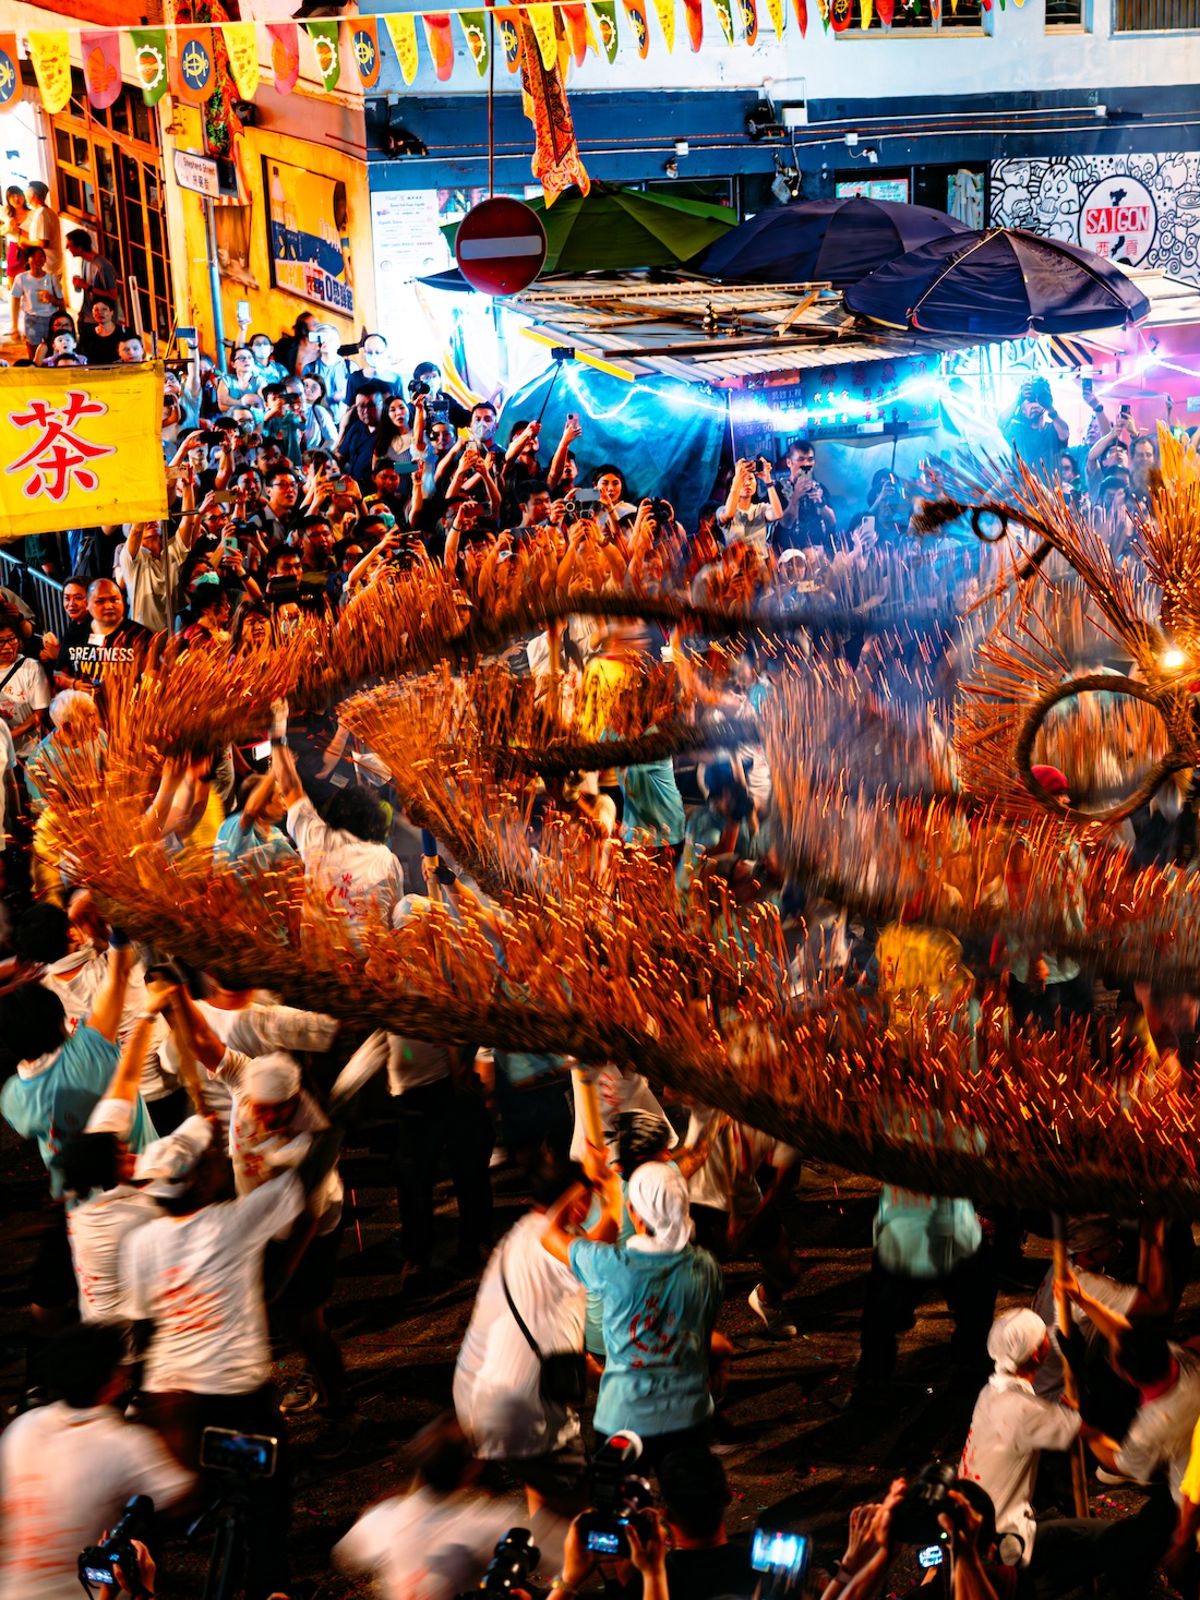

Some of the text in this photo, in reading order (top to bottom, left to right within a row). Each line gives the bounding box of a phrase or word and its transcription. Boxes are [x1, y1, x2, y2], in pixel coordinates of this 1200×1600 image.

[1087, 207, 1150, 233] SAIGON
[1096, 240, 1138, 257] 西 貢
[7, 391, 116, 502] 茶
[69, 646, 135, 662] GREATNESS
